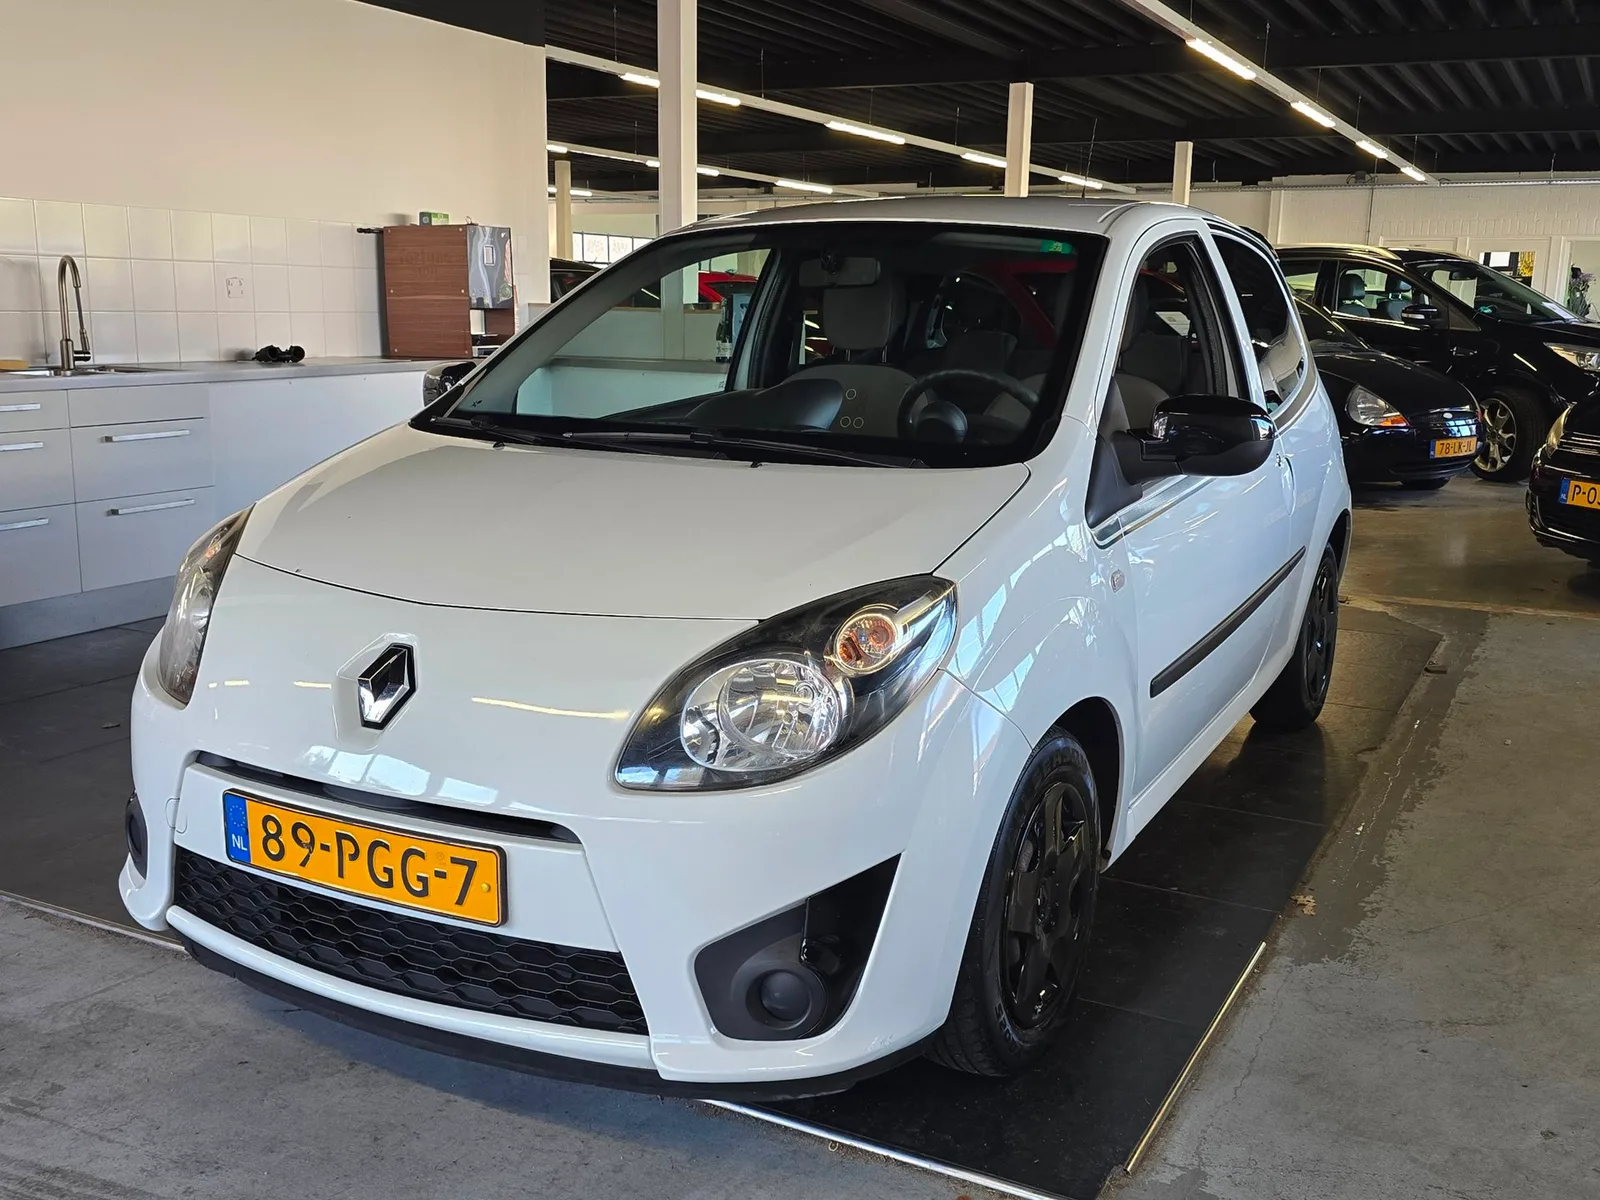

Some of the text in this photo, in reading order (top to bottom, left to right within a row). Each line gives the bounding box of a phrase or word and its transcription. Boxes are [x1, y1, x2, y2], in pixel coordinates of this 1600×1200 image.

[1439, 440, 1473, 455] 78-LK-JL
[1571, 484, 1600, 506] P-0
[231, 833, 248, 852] NL
[261, 814, 478, 906] 89-PGG-7
